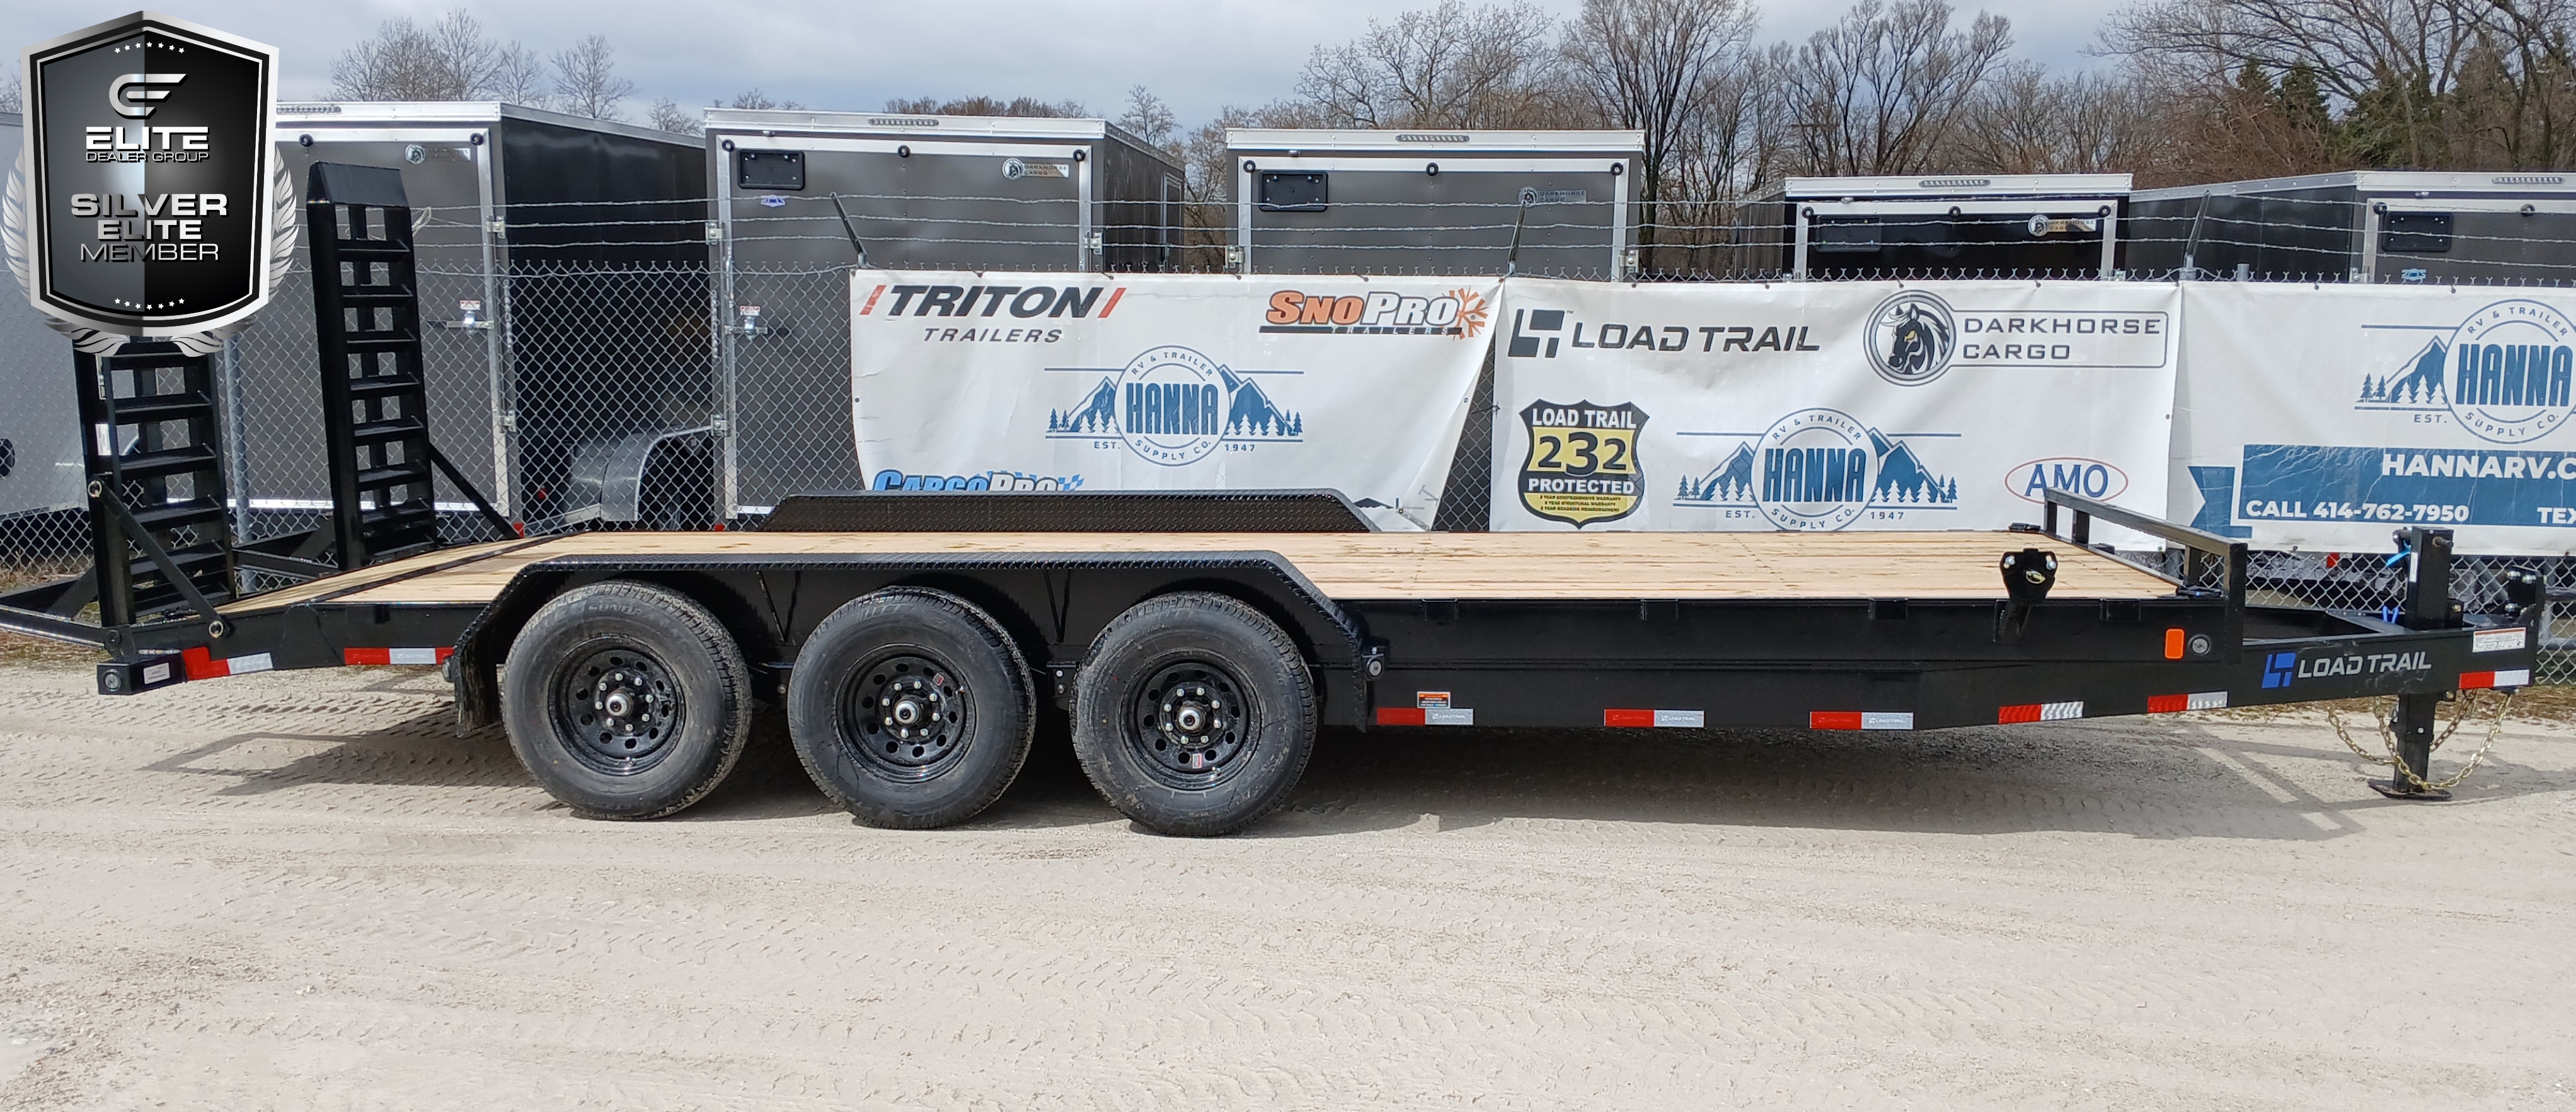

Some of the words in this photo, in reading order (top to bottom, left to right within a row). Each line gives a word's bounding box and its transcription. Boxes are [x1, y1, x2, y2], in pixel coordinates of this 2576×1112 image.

[887, 285, 1104, 318] TRITON
[1964, 318, 2161, 335] DARKHORSE
[2467, 318, 2483, 334] RV
[2509, 306, 2568, 336] TRAILER
[923, 328, 1062, 344] TRAILERS
[1572, 322, 1689, 352] LOAD
[1699, 325, 1820, 352] TRAIL
[1963, 344, 2071, 360] CARGO
[1132, 362, 1145, 376] RV
[1163, 352, 1213, 376] TRAILER
[2455, 344, 2573, 407] HANNA
[1126, 382, 1219, 436] HANNA
[1532, 408, 1579, 427] LOAD
[1584, 410, 1636, 429] TRAIL
[2413, 414, 2447, 424] EST.
[1772, 426, 1786, 441] RV
[1808, 414, 1861, 440] TRAILER
[2465, 412, 2526, 437] SUPPLY
[2537, 413, 2560, 429] CO.
[1094, 441, 1121, 450] EST.
[1135, 439, 1185, 460] SUPPLY
[1193, 441, 1211, 455] CO.
[1224, 444, 1255, 453] 1947
[1538, 431, 1628, 474] 232
[1528, 478, 1635, 494] PROTECTED
[1762, 448, 1866, 502] HANNA
[2023, 464, 2108, 498] AMO
[1725, 510, 1756, 519] EST.
[1771, 509, 1826, 529] SUPPLY
[1835, 508, 1854, 523] CO.
[1870, 511, 1905, 521] 1947
[2246, 500, 2308, 519] CALL
[2313, 502, 2470, 523] 414-762-7950
[2297, 656, 2363, 678] LOAD
[2367, 651, 2432, 674] TRAIL
